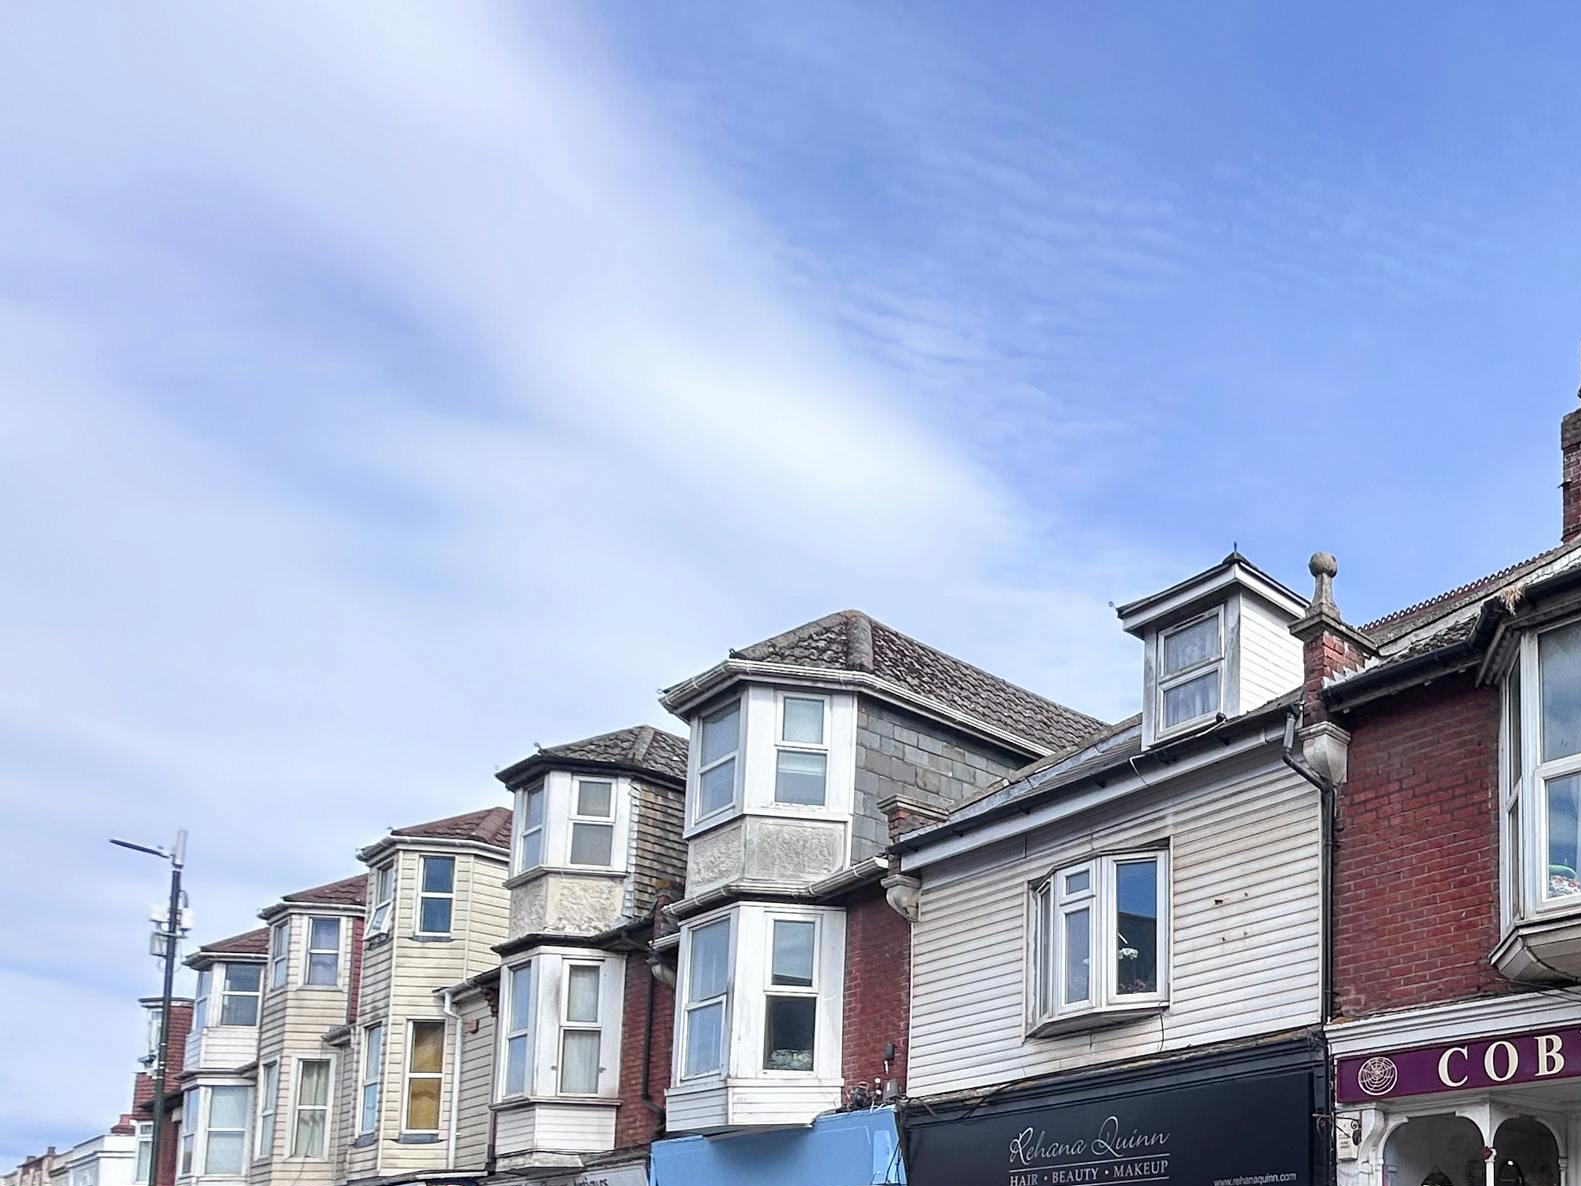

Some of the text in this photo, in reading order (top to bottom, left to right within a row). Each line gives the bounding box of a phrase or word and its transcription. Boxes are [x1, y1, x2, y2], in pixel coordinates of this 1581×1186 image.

[1009, 1115, 1172, 1166] Rehana Quinn
[1052, 1167, 1100, 1184] BEAUTY
[1112, 1159, 1170, 1178] MAKEUP
